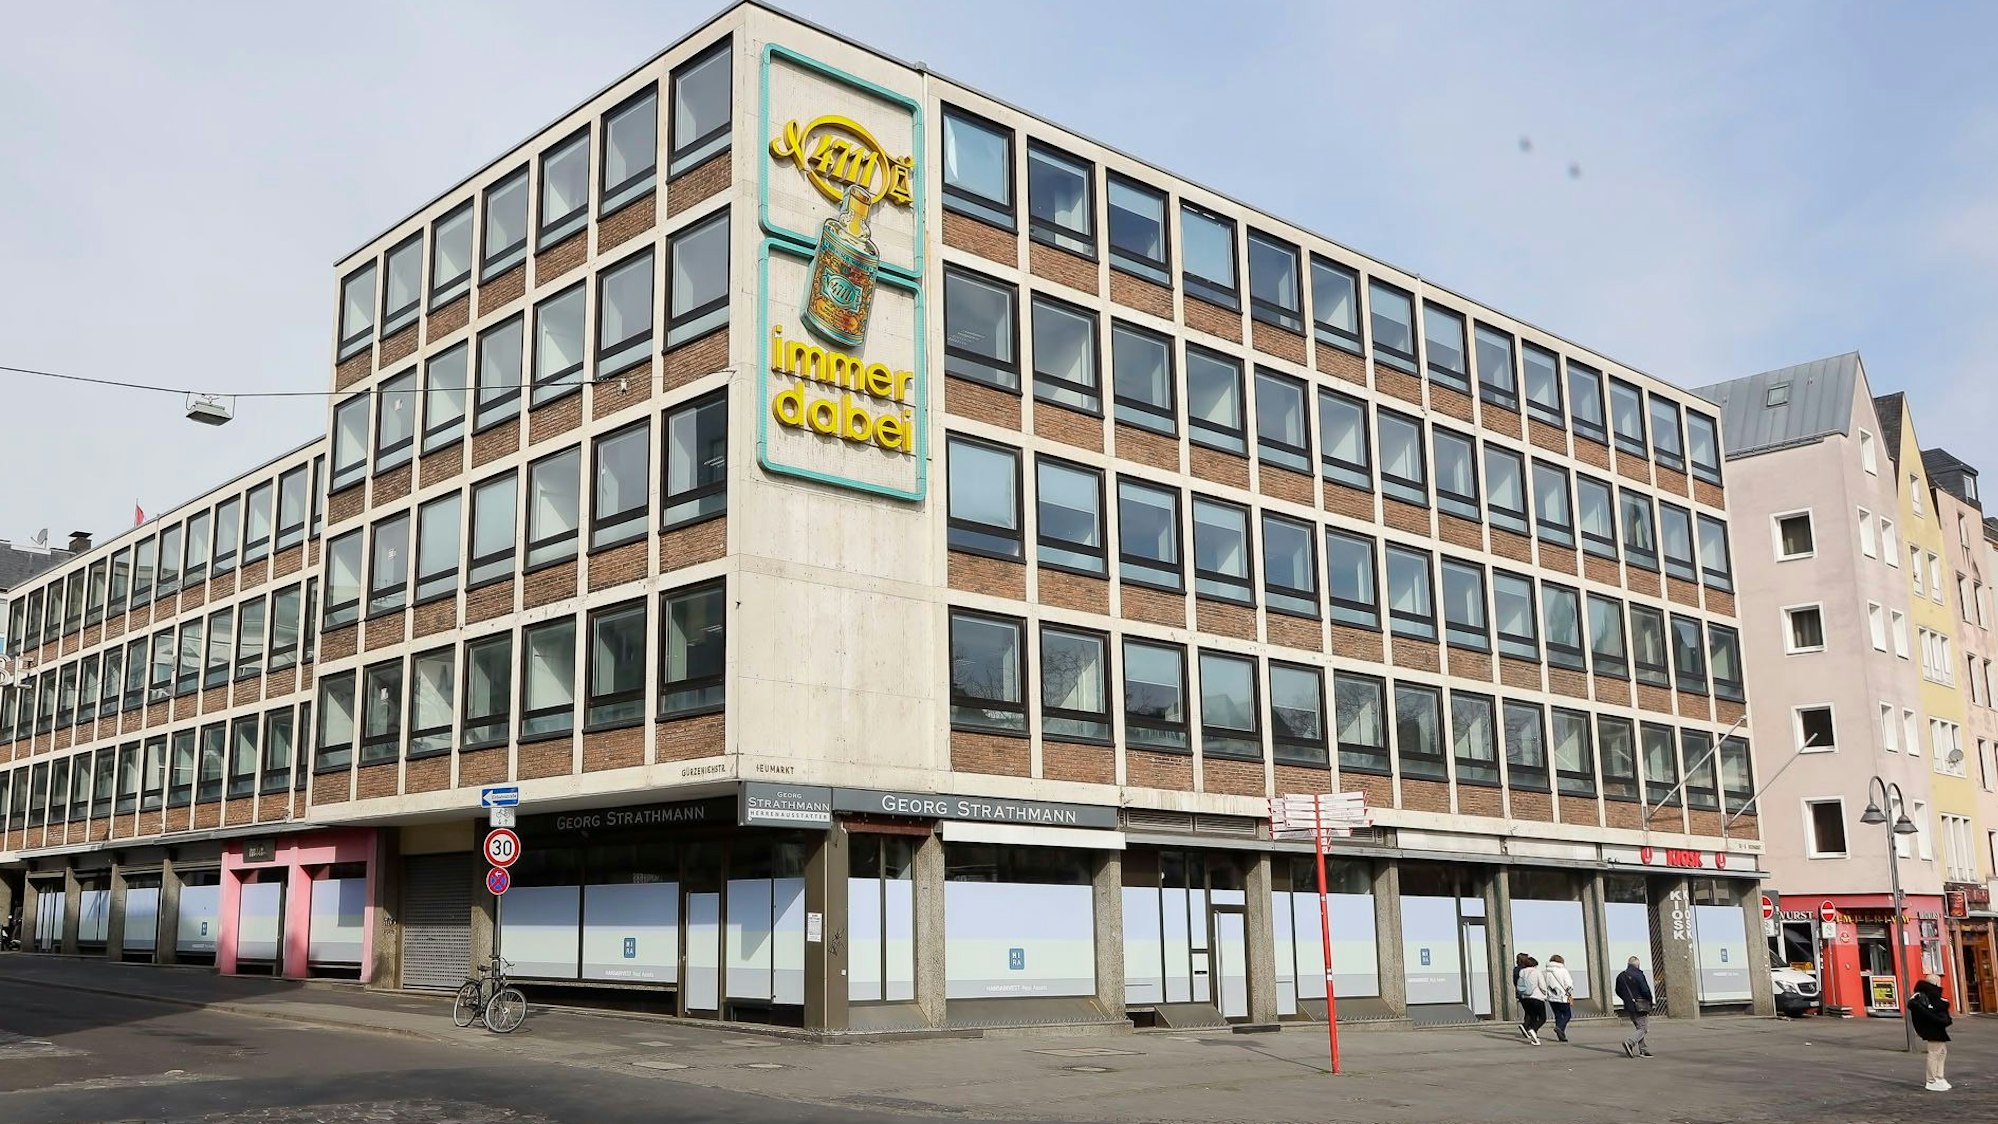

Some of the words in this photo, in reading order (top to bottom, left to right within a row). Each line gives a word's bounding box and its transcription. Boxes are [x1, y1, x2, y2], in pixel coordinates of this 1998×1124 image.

[807, 133, 879, 189] 4711
[771, 325, 914, 402] immer
[772, 381, 912, 453] dabei
[748, 796, 830, 812] STRATHMANN
[777, 791, 802, 799] GEORG
[882, 794, 948, 815] GEORG
[957, 800, 1076, 824] STRATHMANN
[556, 811, 601, 831] GEORG
[606, 805, 705, 826] STRATHMANN
[750, 810, 828, 820] HERRENAUSSTATTER
[492, 839, 512, 856] 30
[1665, 849, 1703, 868] KIOSK
[1669, 890, 1686, 941] KIOSK
[1682, 889, 1693, 940] KIOSK
